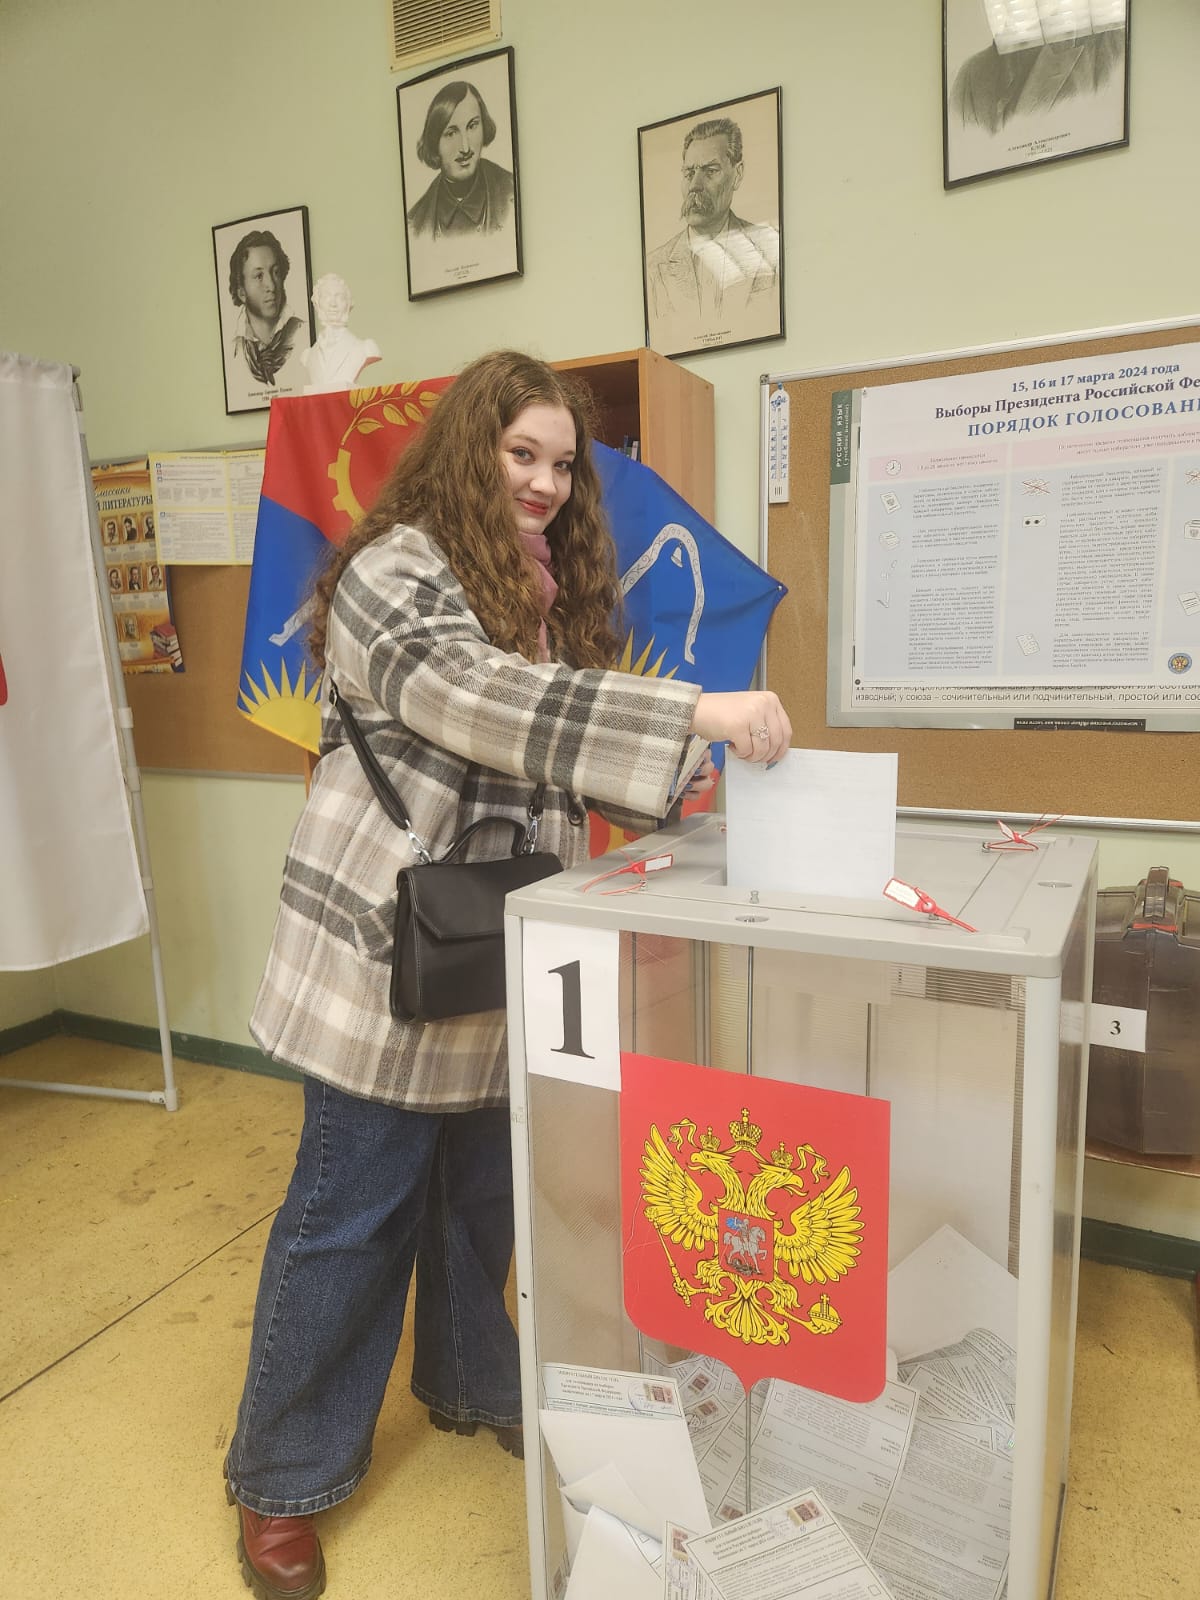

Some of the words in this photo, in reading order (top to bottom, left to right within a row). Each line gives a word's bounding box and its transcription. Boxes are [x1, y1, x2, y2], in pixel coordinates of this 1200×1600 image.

[1011, 382, 1029, 393] 15,
[1032, 379, 1046, 390] 16
[1049, 379, 1057, 388] и
[1061, 375, 1074, 386] 17
[1077, 372, 1115, 386] марта
[1118, 366, 1148, 380] 2024
[1151, 364, 1180, 375] года
[935, 404, 991, 419] Выборы
[995, 393, 1081, 413] Президента
[1085, 377, 1174, 401] Российской
[1179, 376, 1200, 389] Фе
[967, 414, 1059, 437] ПОРЯДОК
[102, 494, 153, 511] ЛИТЕРАТУРЫ
[855, 693, 897, 702] изводный;
[899, 694, 904, 702] у
[941, 693, 1011, 701] сочинительный
[1118, 693, 1160, 702] простой
[548, 960, 595, 1059] 1
[1110, 1020, 1121, 1035] 3
